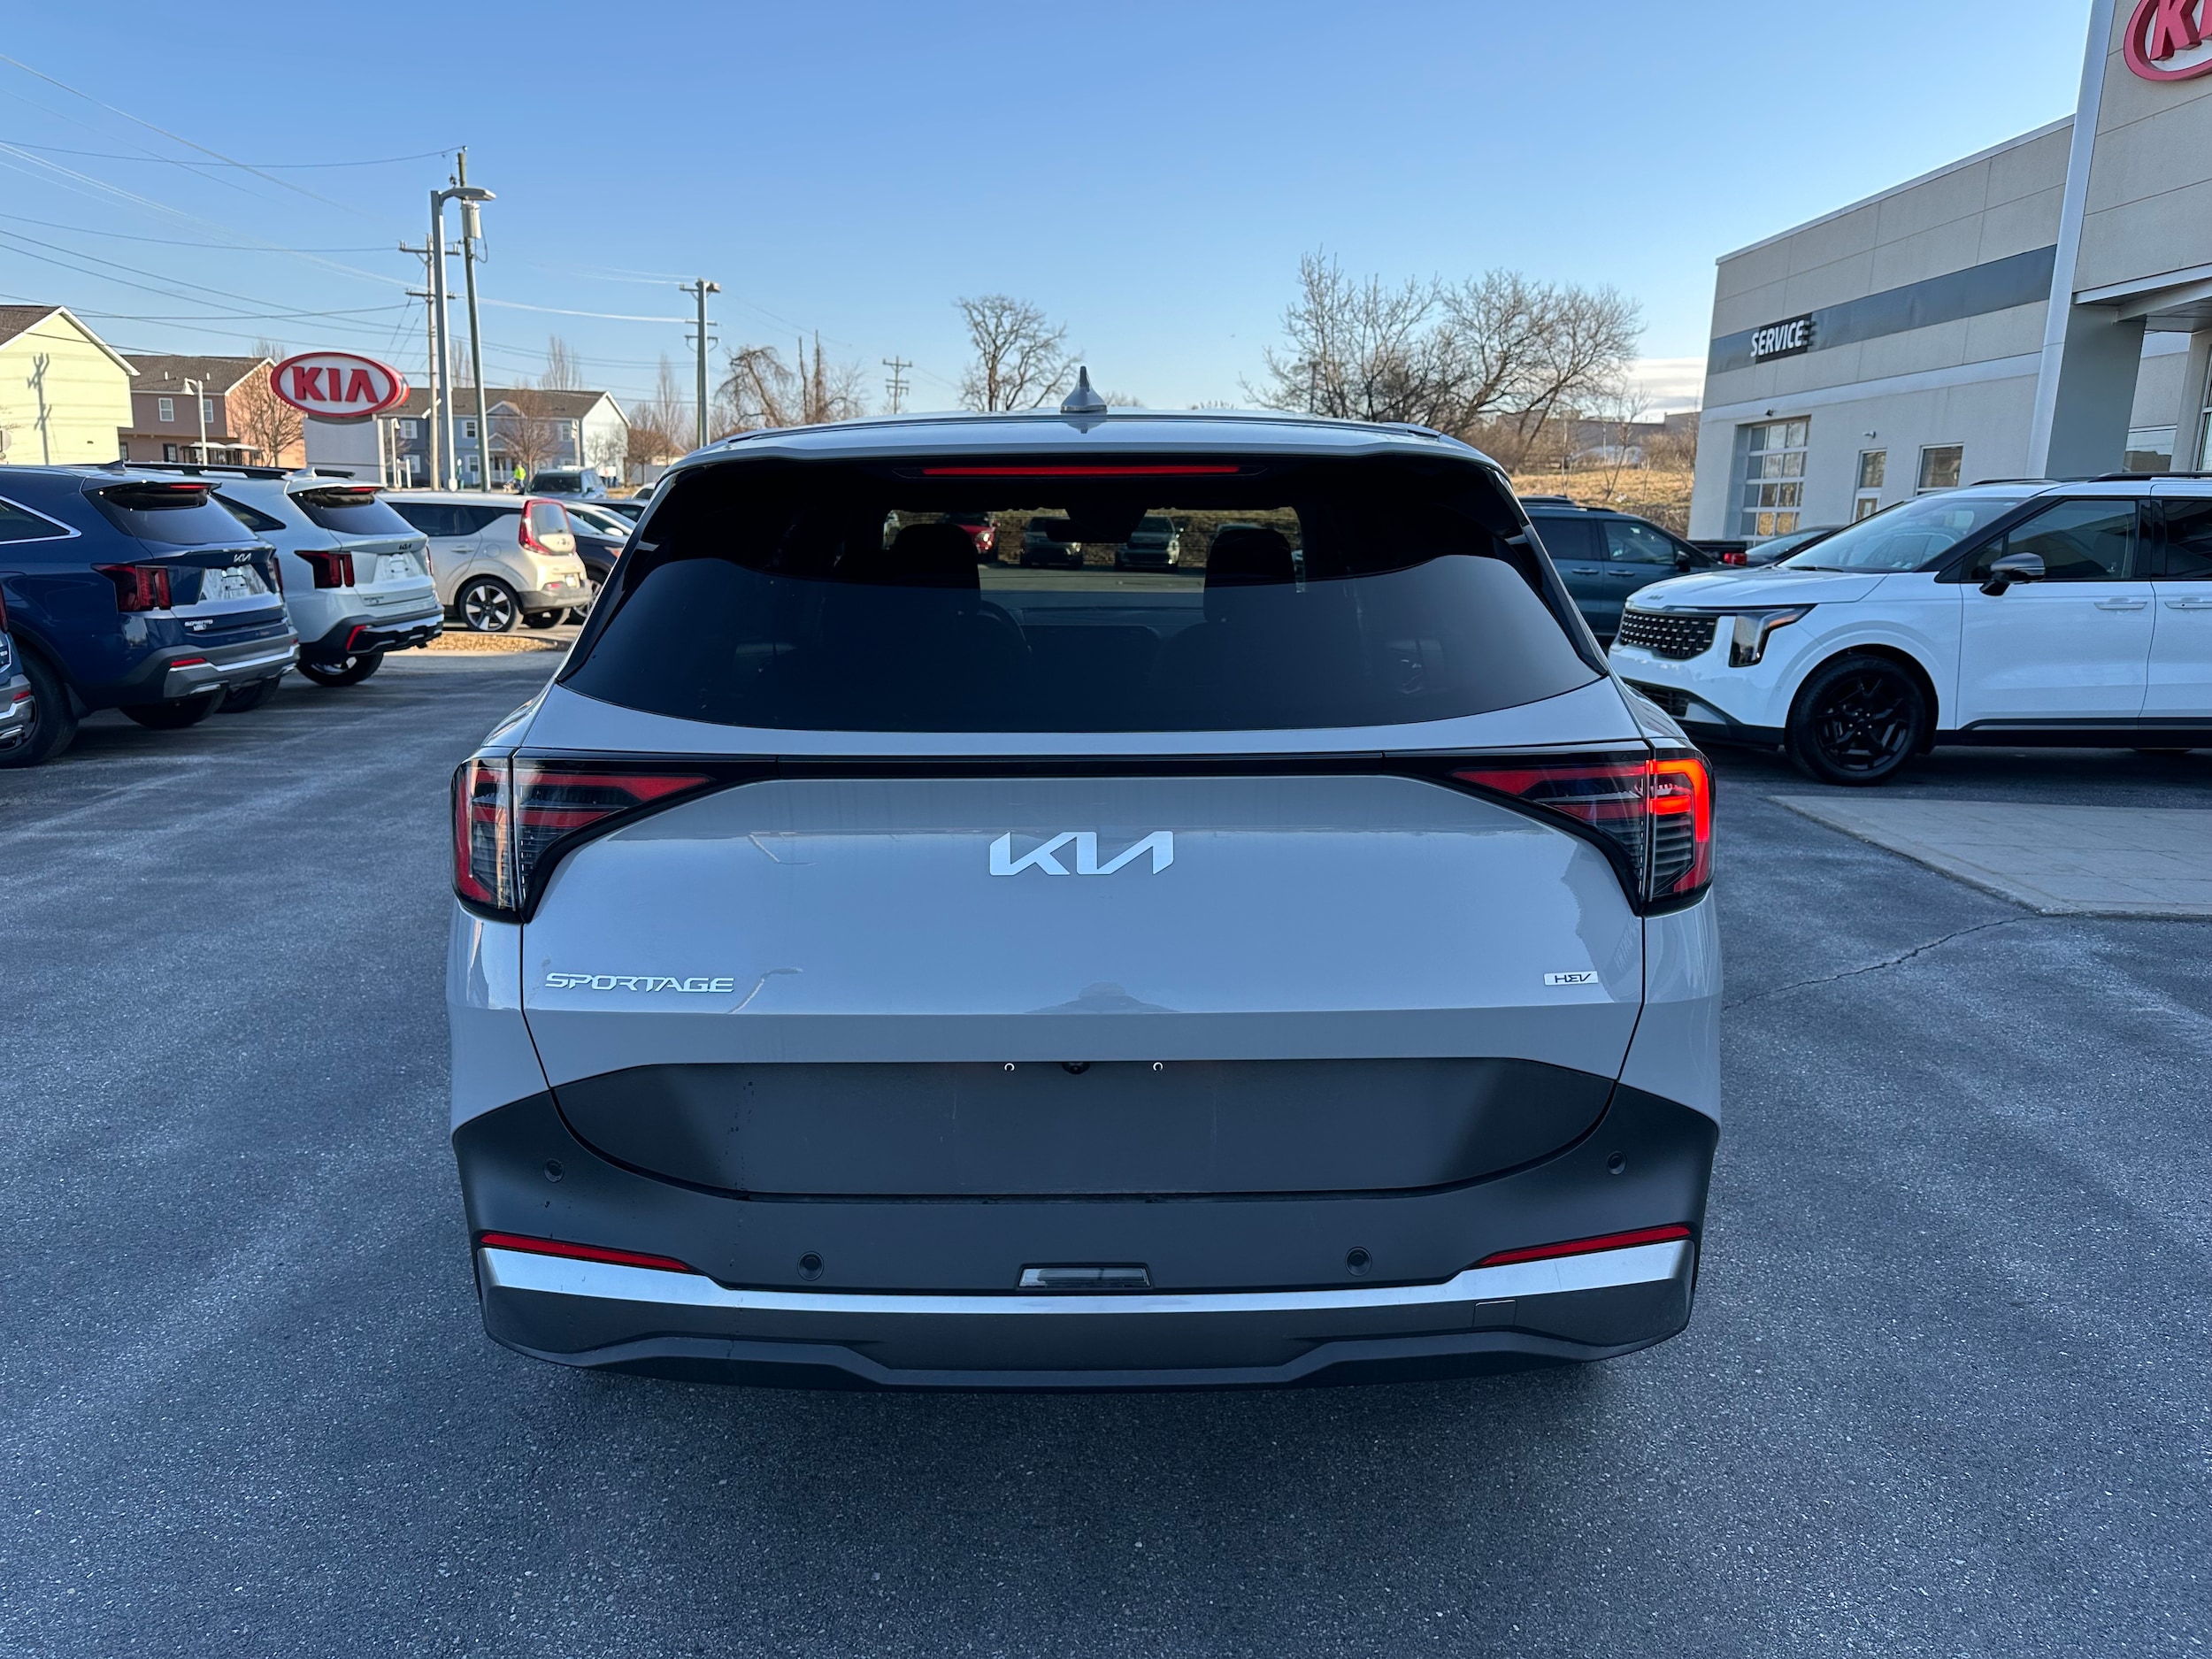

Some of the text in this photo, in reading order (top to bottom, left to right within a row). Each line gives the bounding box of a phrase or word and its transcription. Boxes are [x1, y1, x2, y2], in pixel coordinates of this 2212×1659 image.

[1750, 319, 1805, 357] SERVICE
[291, 365, 379, 403] KIA
[234, 553, 251, 563] KIA
[989, 831, 1174, 876] KIA
[545, 972, 734, 993] SPORTAGE
[1555, 973, 1591, 983] HEV
